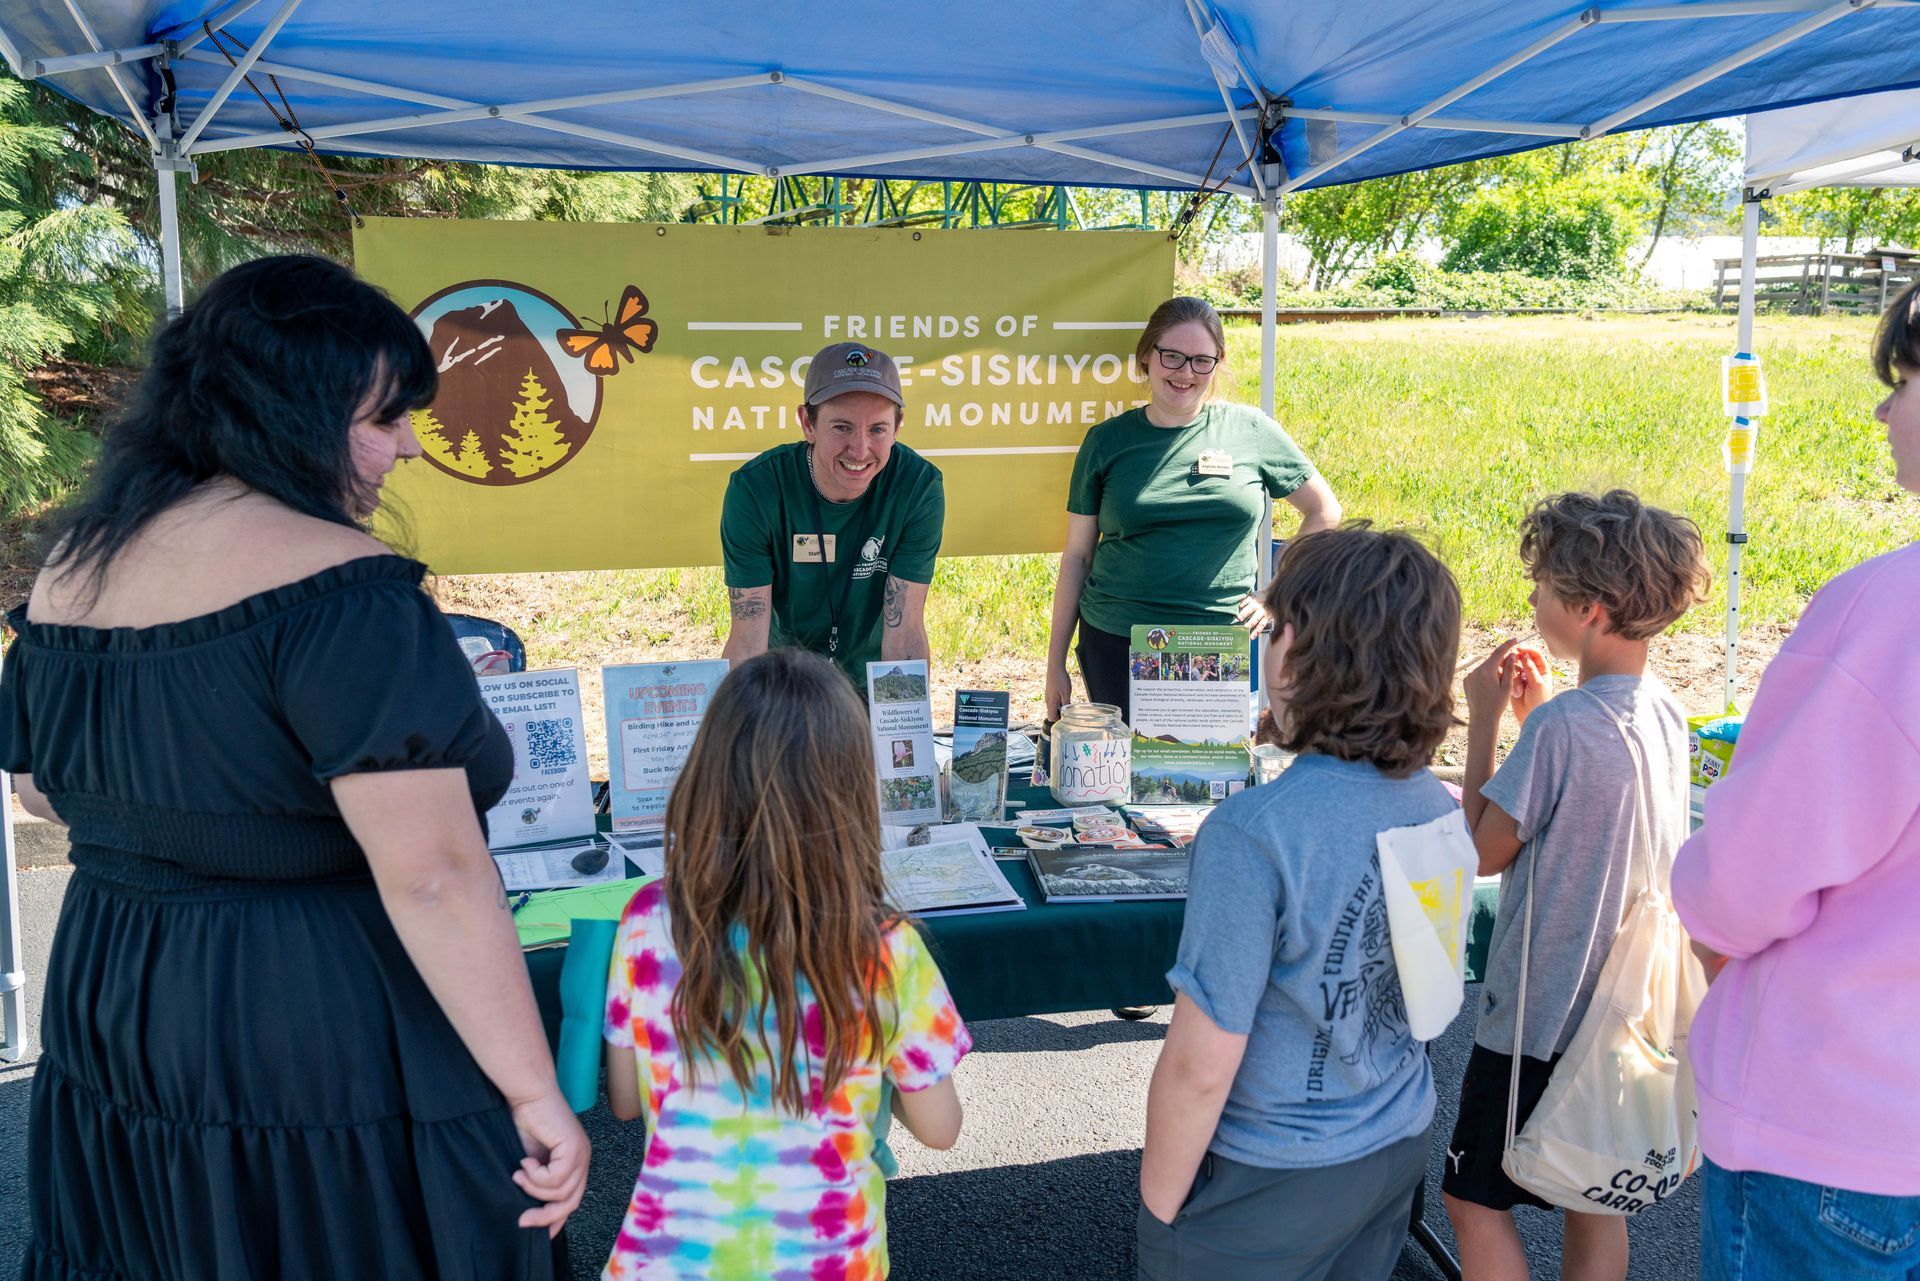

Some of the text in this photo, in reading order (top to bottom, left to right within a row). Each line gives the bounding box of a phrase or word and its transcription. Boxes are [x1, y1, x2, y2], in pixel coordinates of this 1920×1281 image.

[823, 315, 1038, 339] FRIENDS OF
[690, 353, 1150, 389] CASCE-SISKIYOU
[480, 677, 570, 693] LOW US ON SOCIAL
[628, 682, 707, 700] UPCOMING
[491, 695, 505, 703] OR
[507, 690, 560, 702] SUBSCRIBE
[562, 688, 575, 697] TO
[502, 704, 532, 715] EMAIL
[534, 702, 557, 711] LIST!
[644, 698, 698, 714] EVENTS
[881, 708, 913, 716] Wildflowers
[627, 721, 656, 731] Birding
[675, 719, 690, 727] and
[879, 715, 924, 724] Cascade-Siskiyou
[876, 723, 929, 732] National Monument
[633, 746, 650, 754] First
[651, 744, 675, 754] Friday
[676, 743, 689, 751] Art
[1705, 755, 1721, 769] SKINNY
[541, 767, 568, 776] FACEBOOK
[643, 766, 663, 774] Buck
[1702, 763, 1719, 778] POP
[521, 784, 536, 792] out
[566, 779, 575, 787] of
[508, 796, 536, 806] events
[632, 804, 639, 812] to
[1323, 873, 1374, 976] FOOTWEAR
